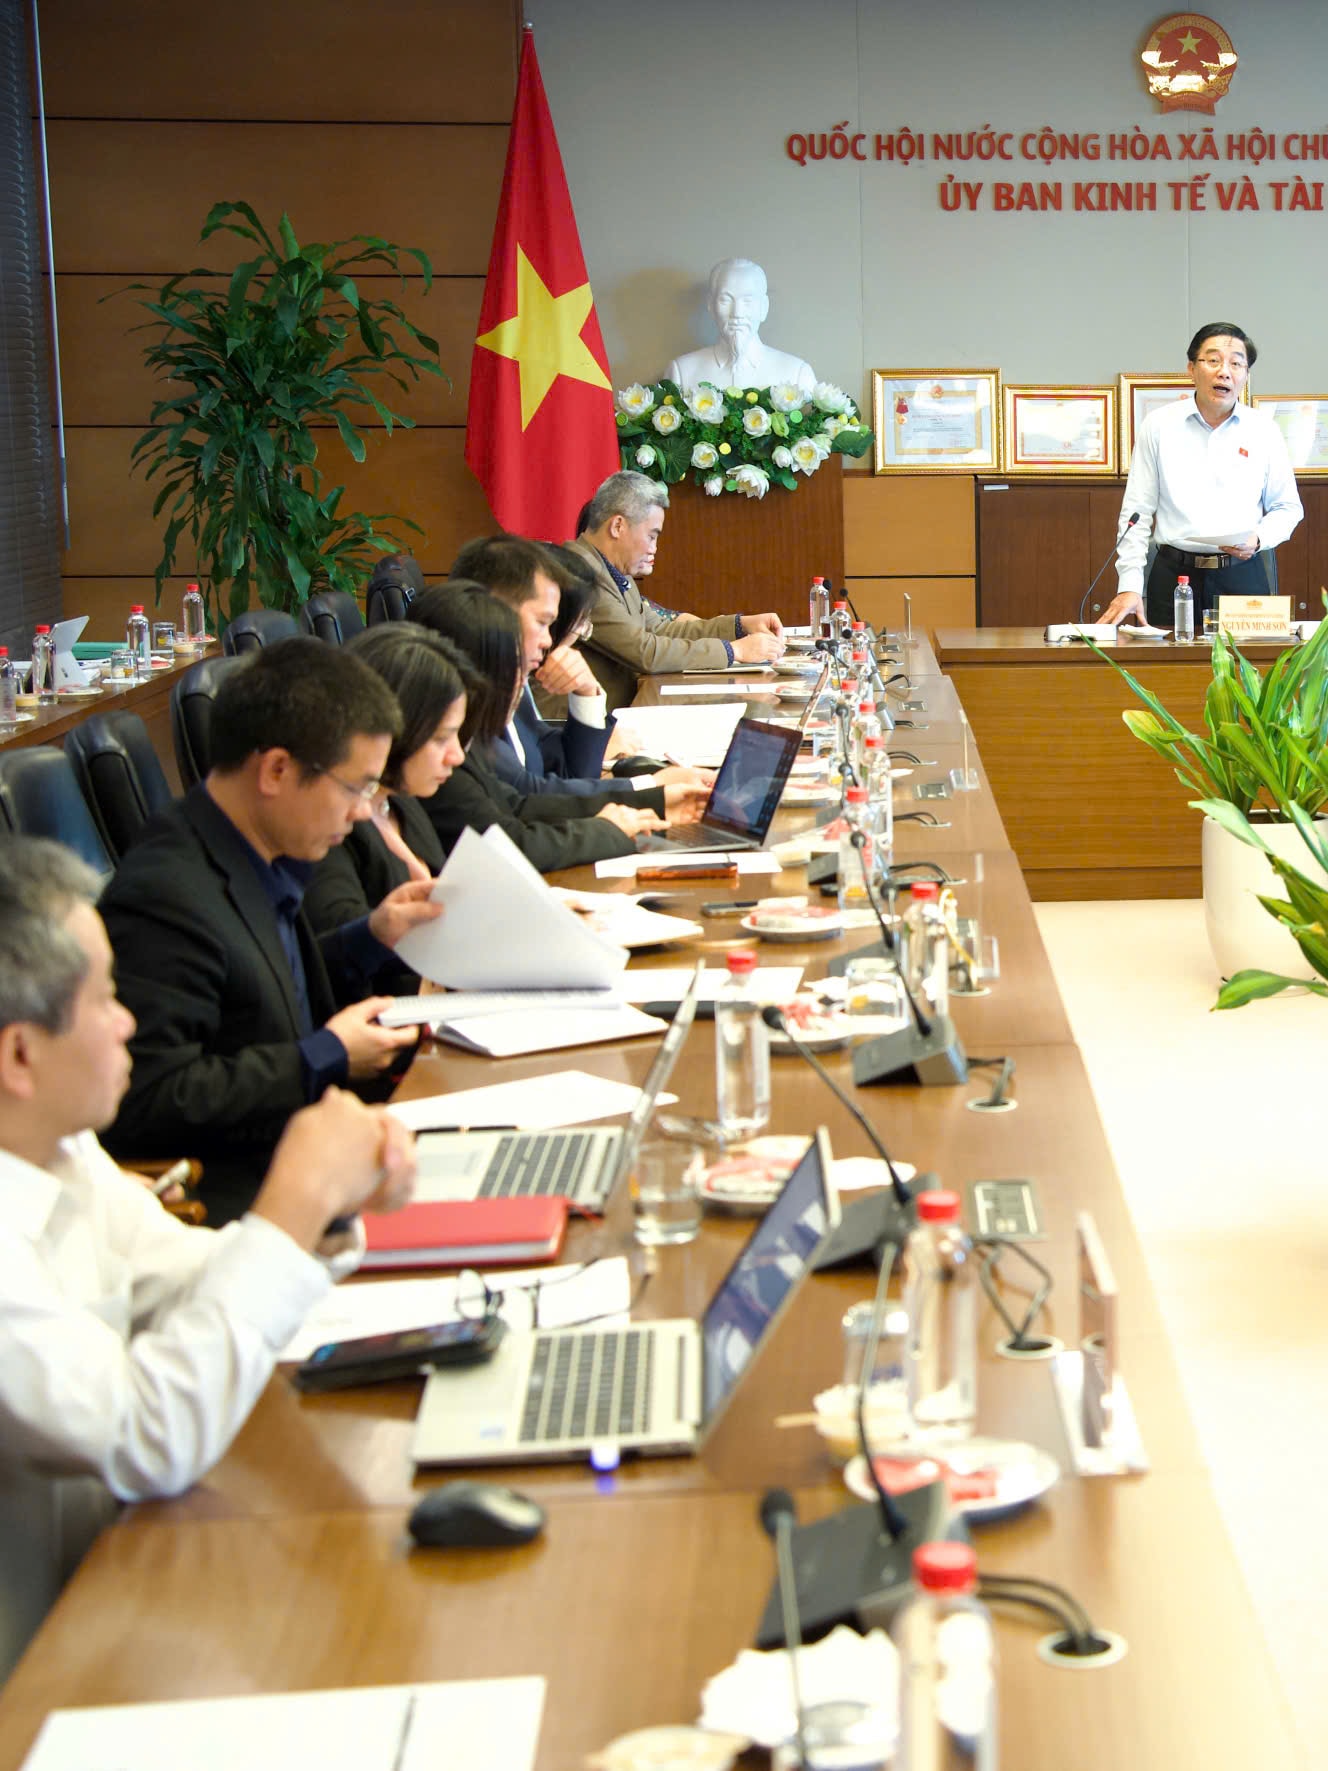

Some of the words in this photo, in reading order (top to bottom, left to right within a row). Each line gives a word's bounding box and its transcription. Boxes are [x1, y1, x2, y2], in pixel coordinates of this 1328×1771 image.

[787, 120, 867, 167] QUỐC
[875, 126, 925, 166] HỘI
[934, 123, 1014, 161] NƯỚC
[1020, 126, 1101, 166] CỘNG
[1109, 124, 1172, 161] HÒA
[1178, 127, 1220, 161] XÃ
[1226, 126, 1276, 166] HỘI
[939, 173, 984, 212] ỦY
[993, 182, 1062, 212] BAN
[1073, 182, 1157, 212] KINH
[1168, 173, 1212, 212] TẾ
[1215, 175, 1260, 212] VÀ
[1269, 176, 1325, 212] TÀI
